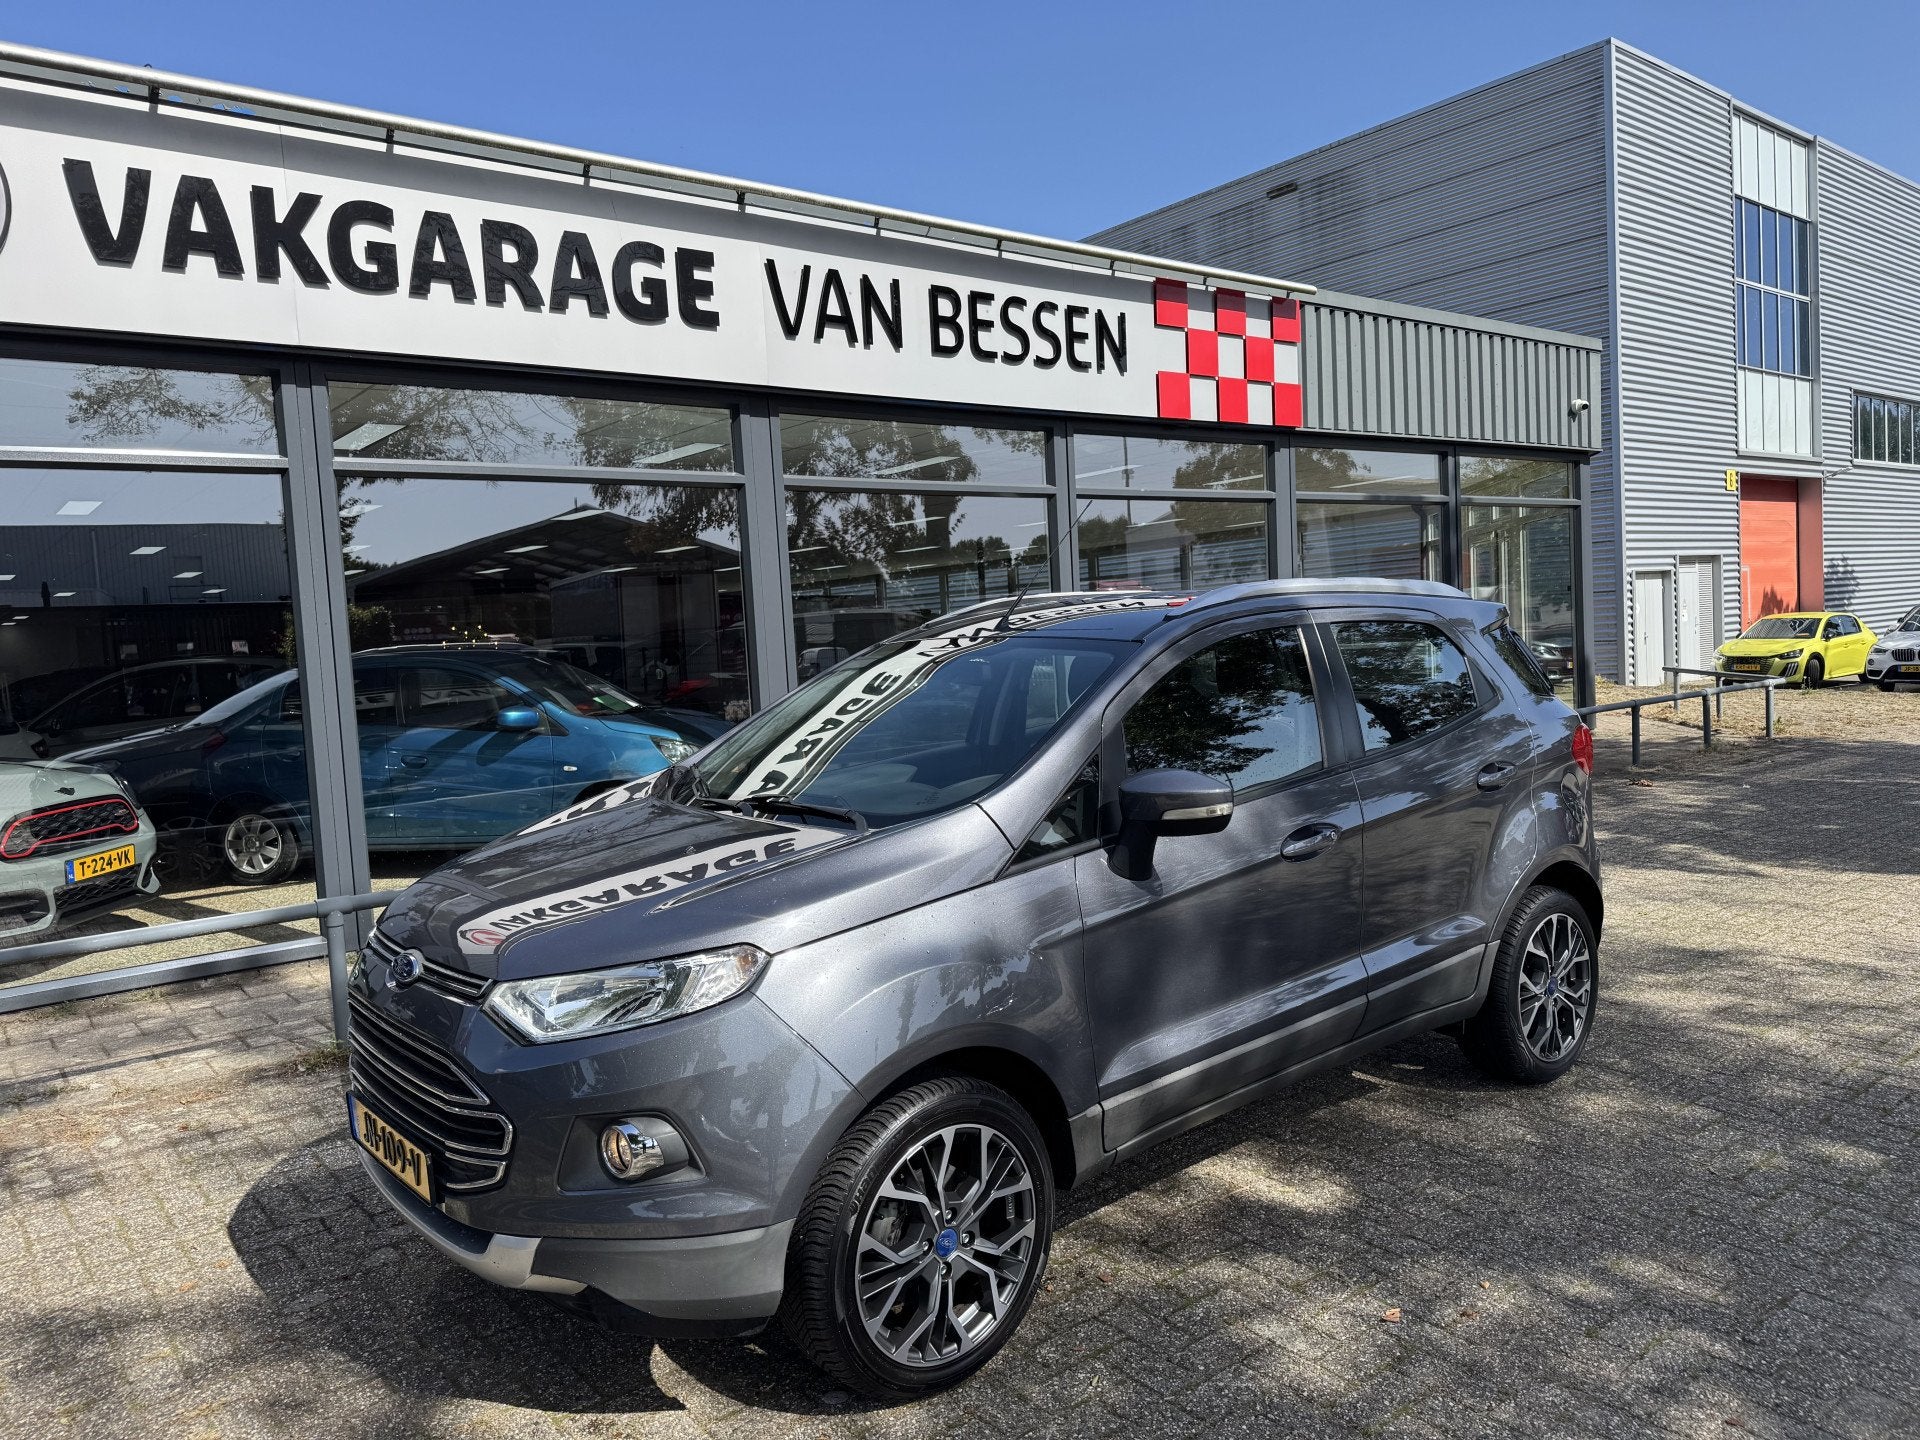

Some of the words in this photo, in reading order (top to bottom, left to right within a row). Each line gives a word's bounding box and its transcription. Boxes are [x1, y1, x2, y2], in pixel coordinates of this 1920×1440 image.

[62, 158, 720, 328] VAKGARAGE
[765, 258, 902, 350] VAN
[929, 284, 1126, 374] BESSEN
[79, 849, 131, 877] T-224-VK
